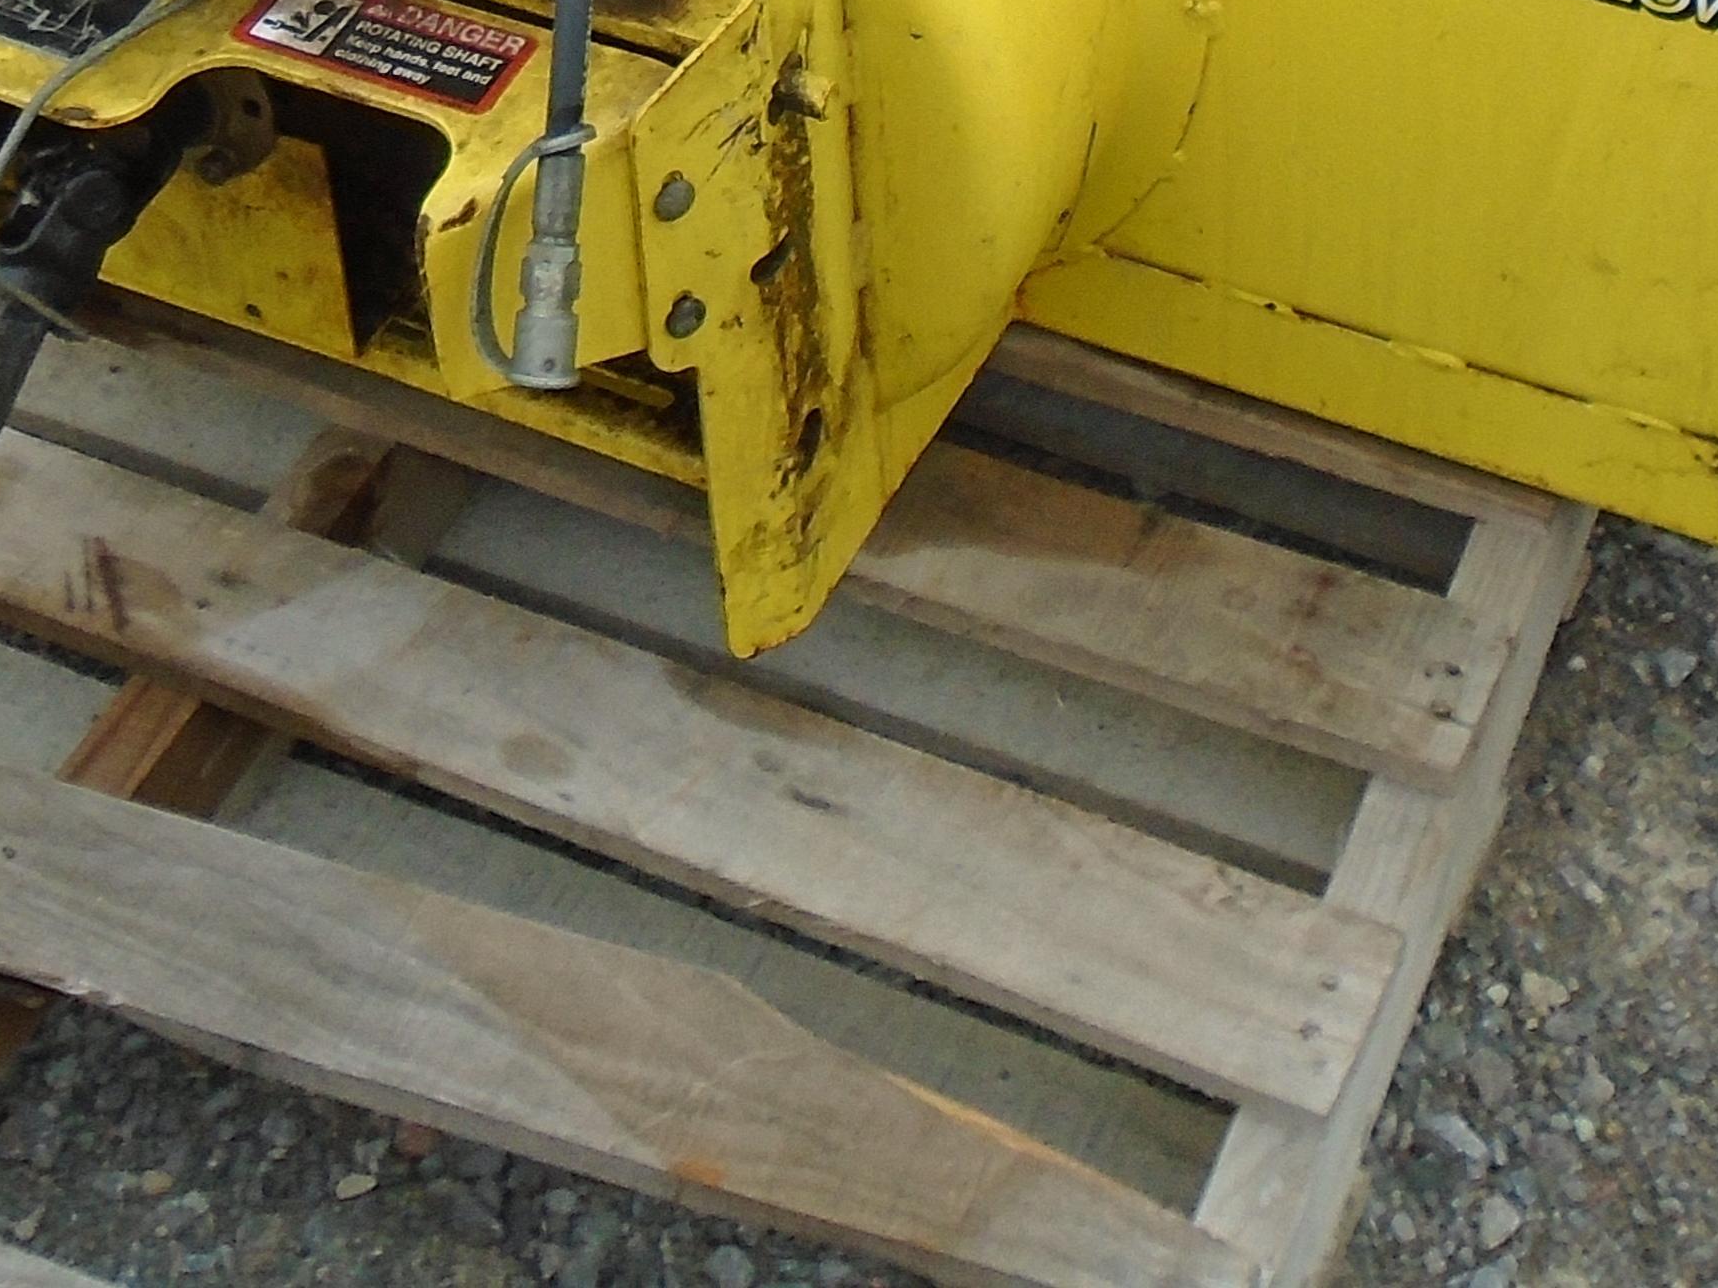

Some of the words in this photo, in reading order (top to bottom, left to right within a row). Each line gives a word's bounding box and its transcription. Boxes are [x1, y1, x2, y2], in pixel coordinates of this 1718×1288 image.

[354, 19, 440, 54] ROTATING
[441, 42, 505, 72] SHAFT
[398, 4, 528, 56] DANGER
[334, 48, 393, 74] clothing
[393, 67, 432, 86] away
[345, 34, 382, 55] Keep
[461, 67, 493, 87] and
